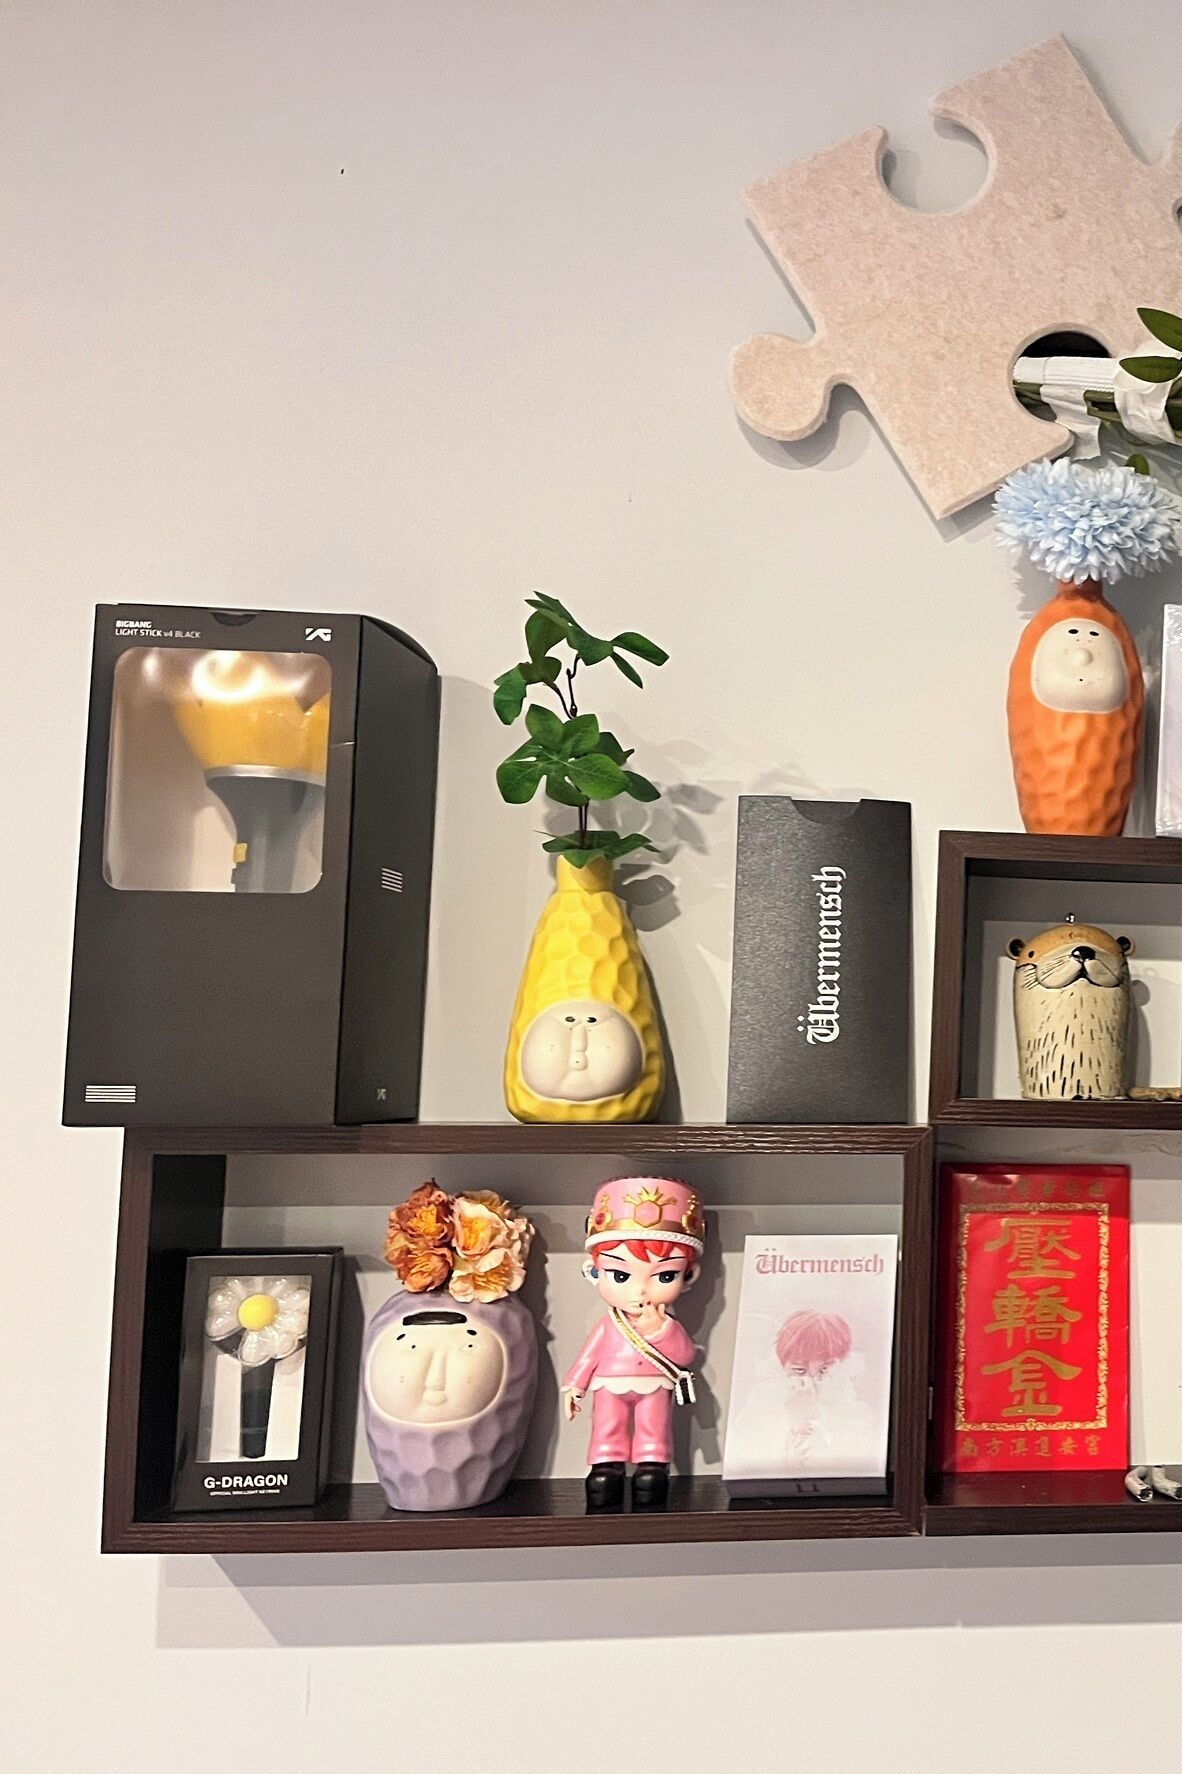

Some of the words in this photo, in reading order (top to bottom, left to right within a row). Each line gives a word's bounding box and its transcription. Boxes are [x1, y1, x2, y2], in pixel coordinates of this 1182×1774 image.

[115, 620, 152, 628] BIGBANG
[115, 628, 139, 636] LIGHT
[140, 629, 162, 637] STICK
[174, 630, 201, 638] BLACK
[797, 866, 847, 1045] Übermensch
[755, 1247, 885, 1276] Übermensch
[204, 1474, 289, 1489] G-DRAGON
